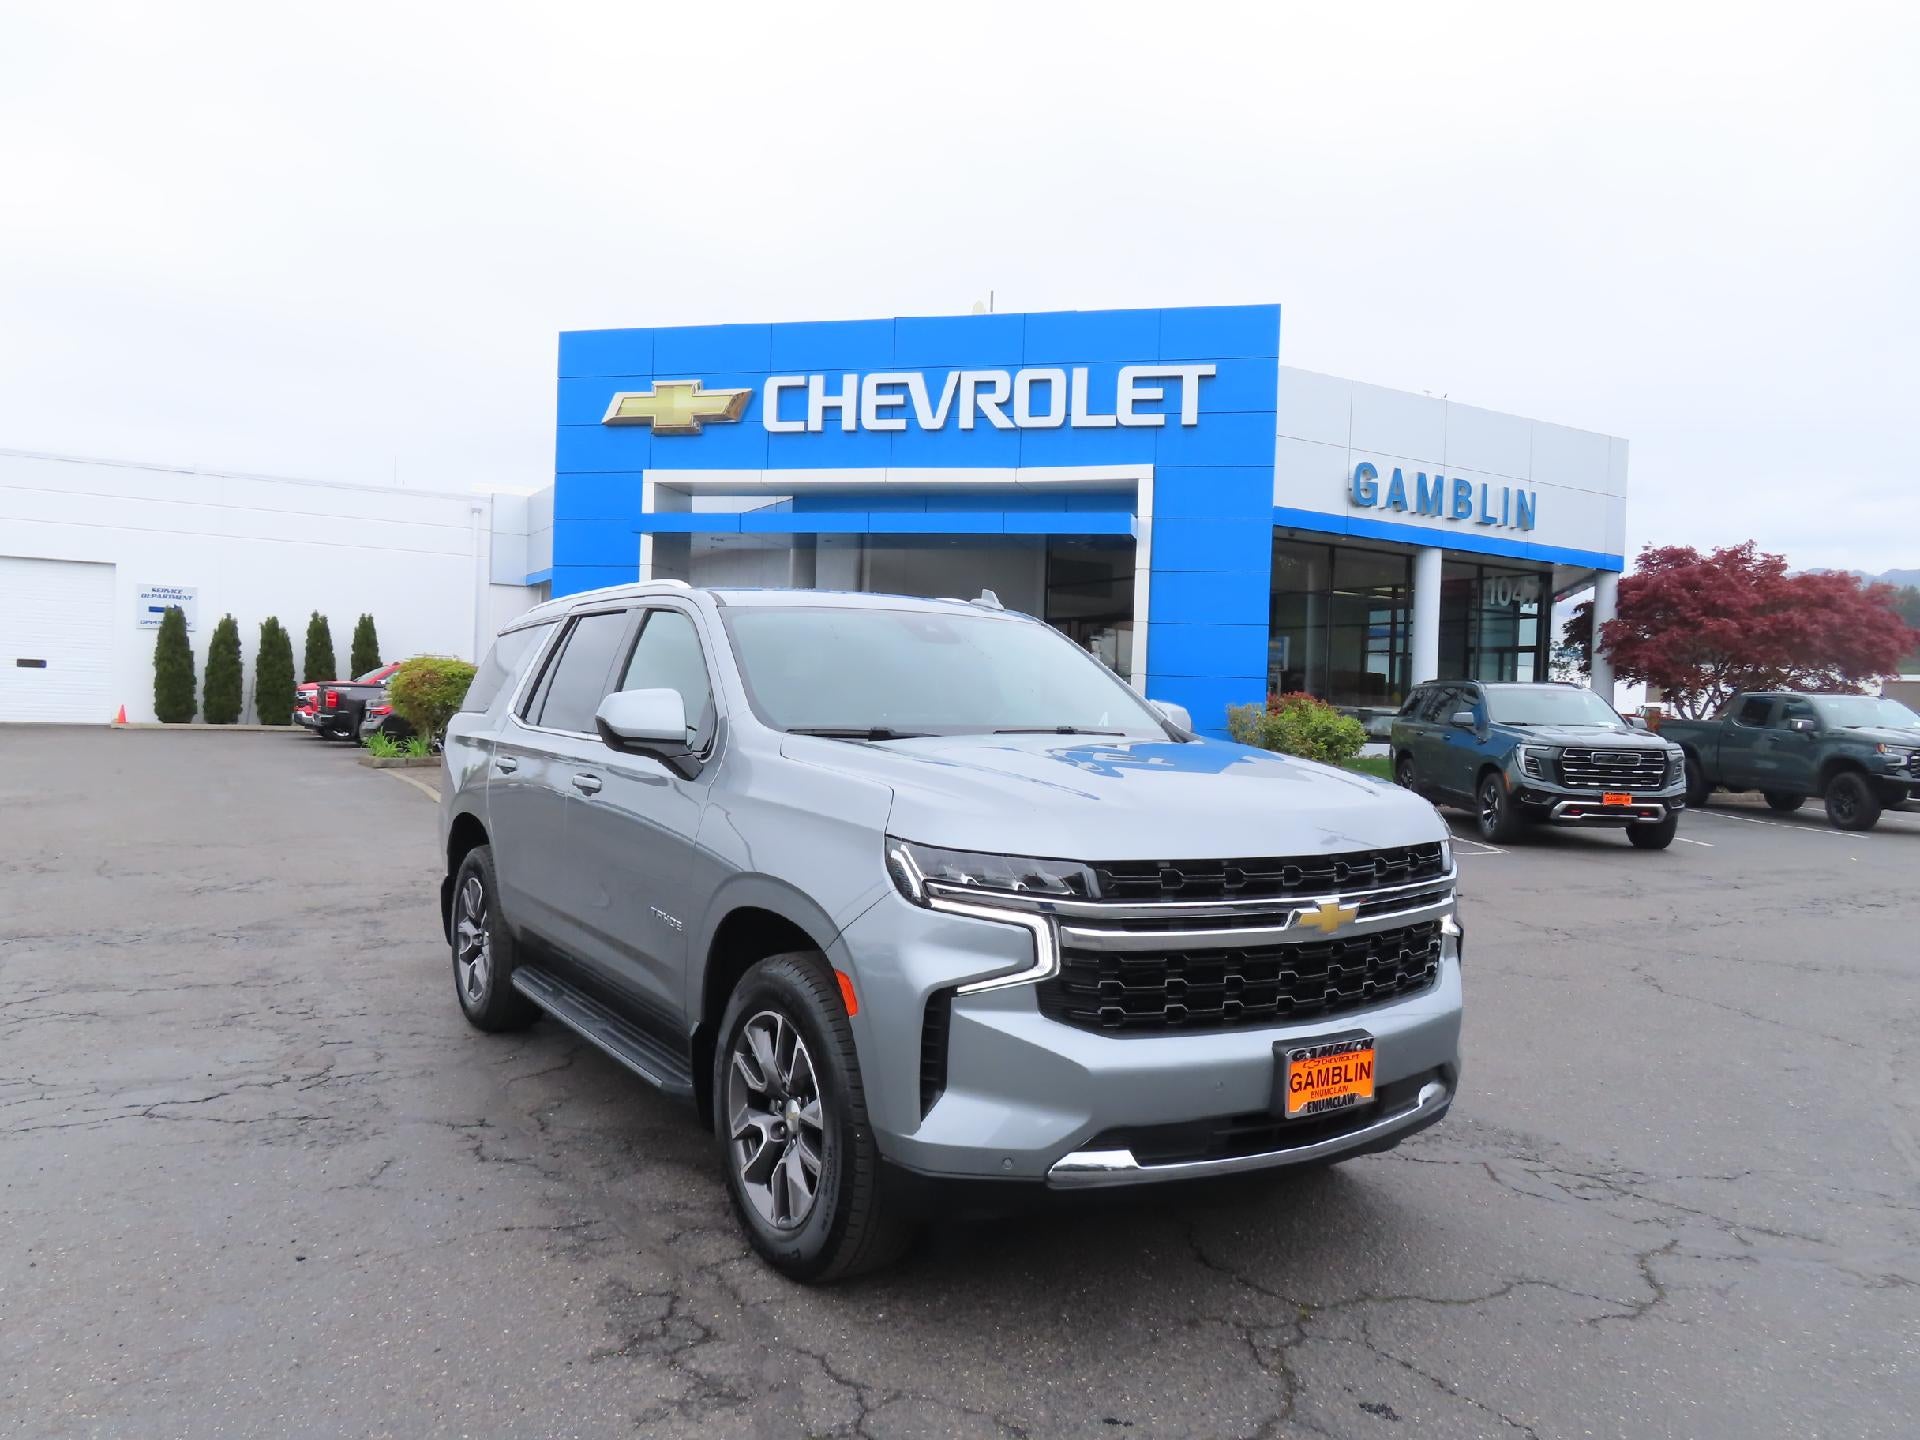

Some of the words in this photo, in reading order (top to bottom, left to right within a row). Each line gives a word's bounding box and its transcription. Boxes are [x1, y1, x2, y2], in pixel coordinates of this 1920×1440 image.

[763, 364, 1216, 432] CHEVROLET
[1351, 461, 1536, 532] GAMBLIN
[140, 593, 193, 601] DEPARTMENT
[1321, 1053, 1360, 1065] CHEVROLET
[1289, 1061, 1372, 1093] GAMBLIN
[1306, 1092, 1359, 1114] ENUMCLAW
[1310, 1085, 1349, 1099] ENUMCLAW
